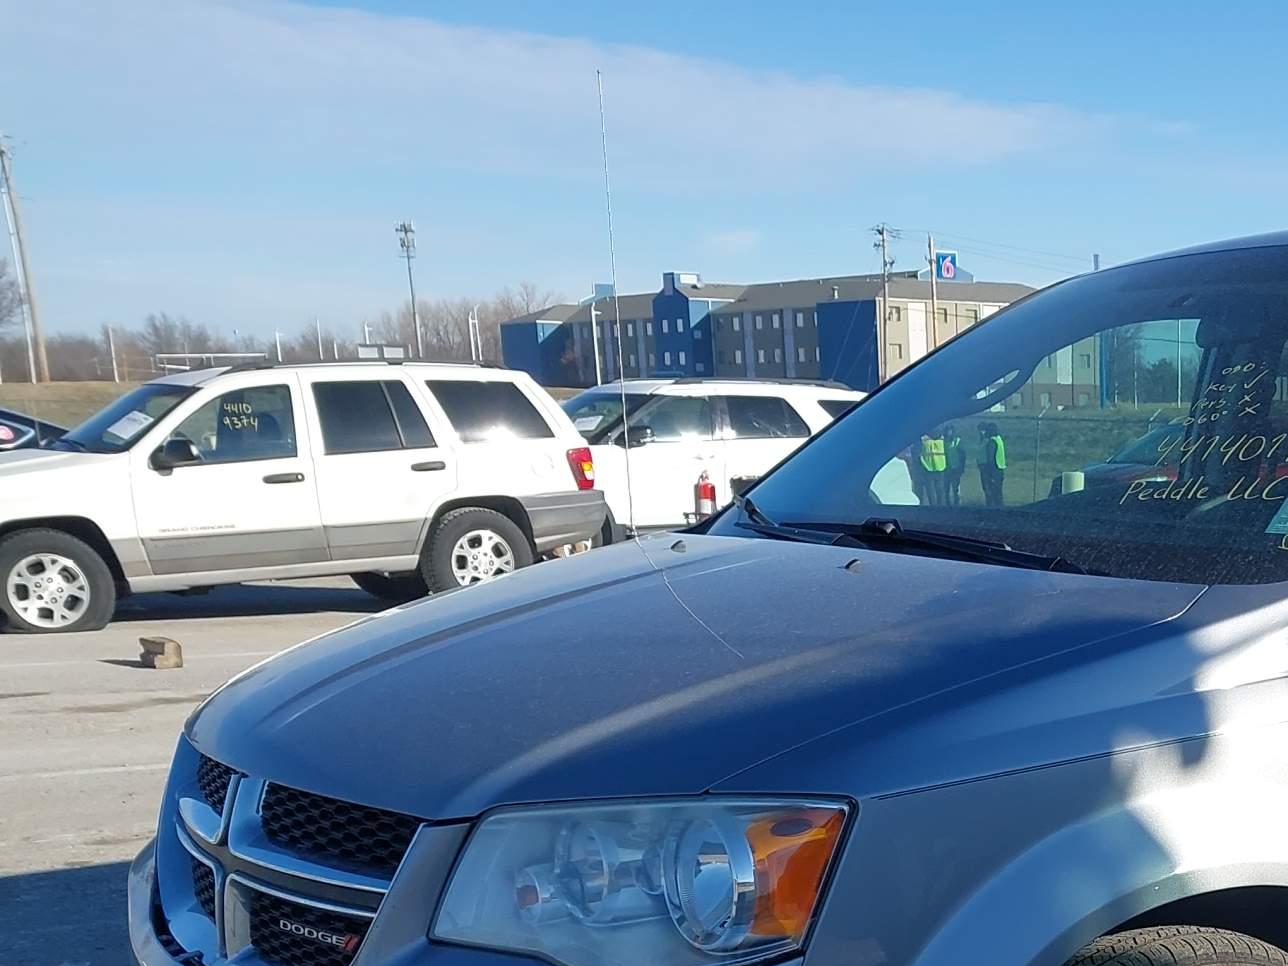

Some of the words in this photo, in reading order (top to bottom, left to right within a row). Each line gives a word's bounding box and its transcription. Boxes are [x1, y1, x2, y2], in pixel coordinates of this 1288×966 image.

[223, 402, 252, 415] 4410
[223, 415, 258, 432] 9374
[1119, 476, 1209, 504] Peddle
[1227, 476, 1288, 501] LLC
[279, 919, 346, 947] DODGE
